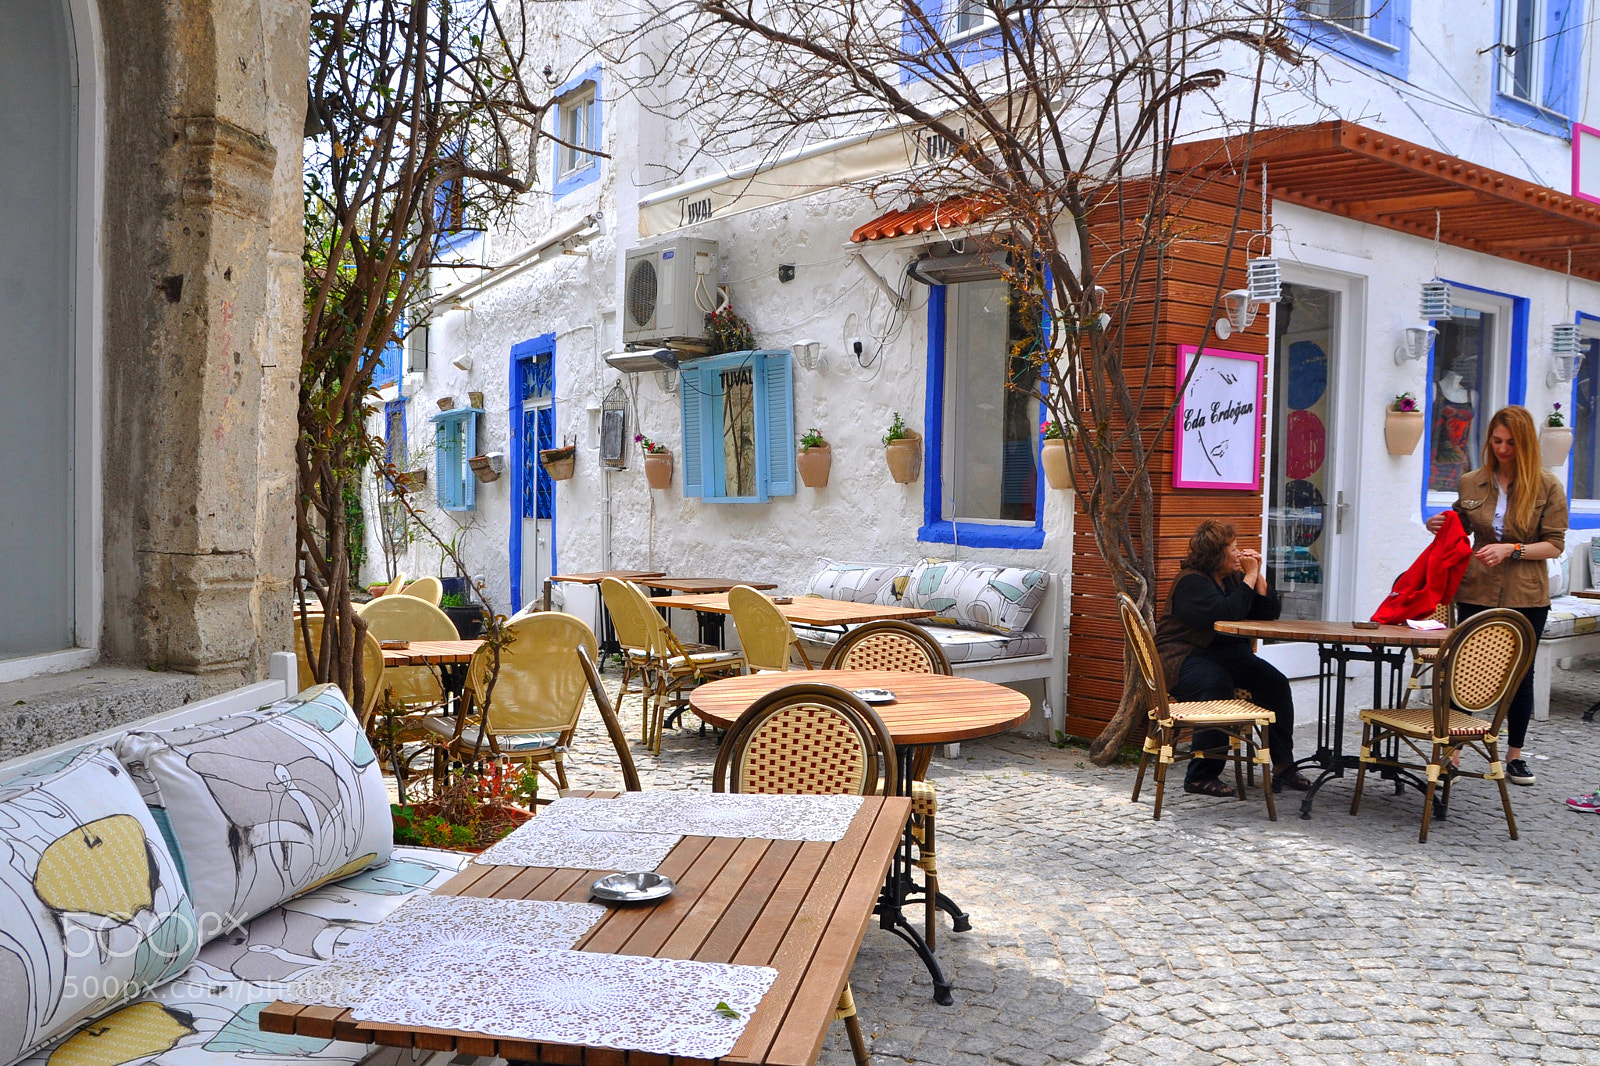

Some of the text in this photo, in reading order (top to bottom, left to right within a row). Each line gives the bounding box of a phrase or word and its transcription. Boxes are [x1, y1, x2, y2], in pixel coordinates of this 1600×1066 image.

[677, 196, 712, 227] TUVAL
[719, 366, 754, 389] TUVAL
[1184, 400, 1253, 431] Eda Erdoğan
